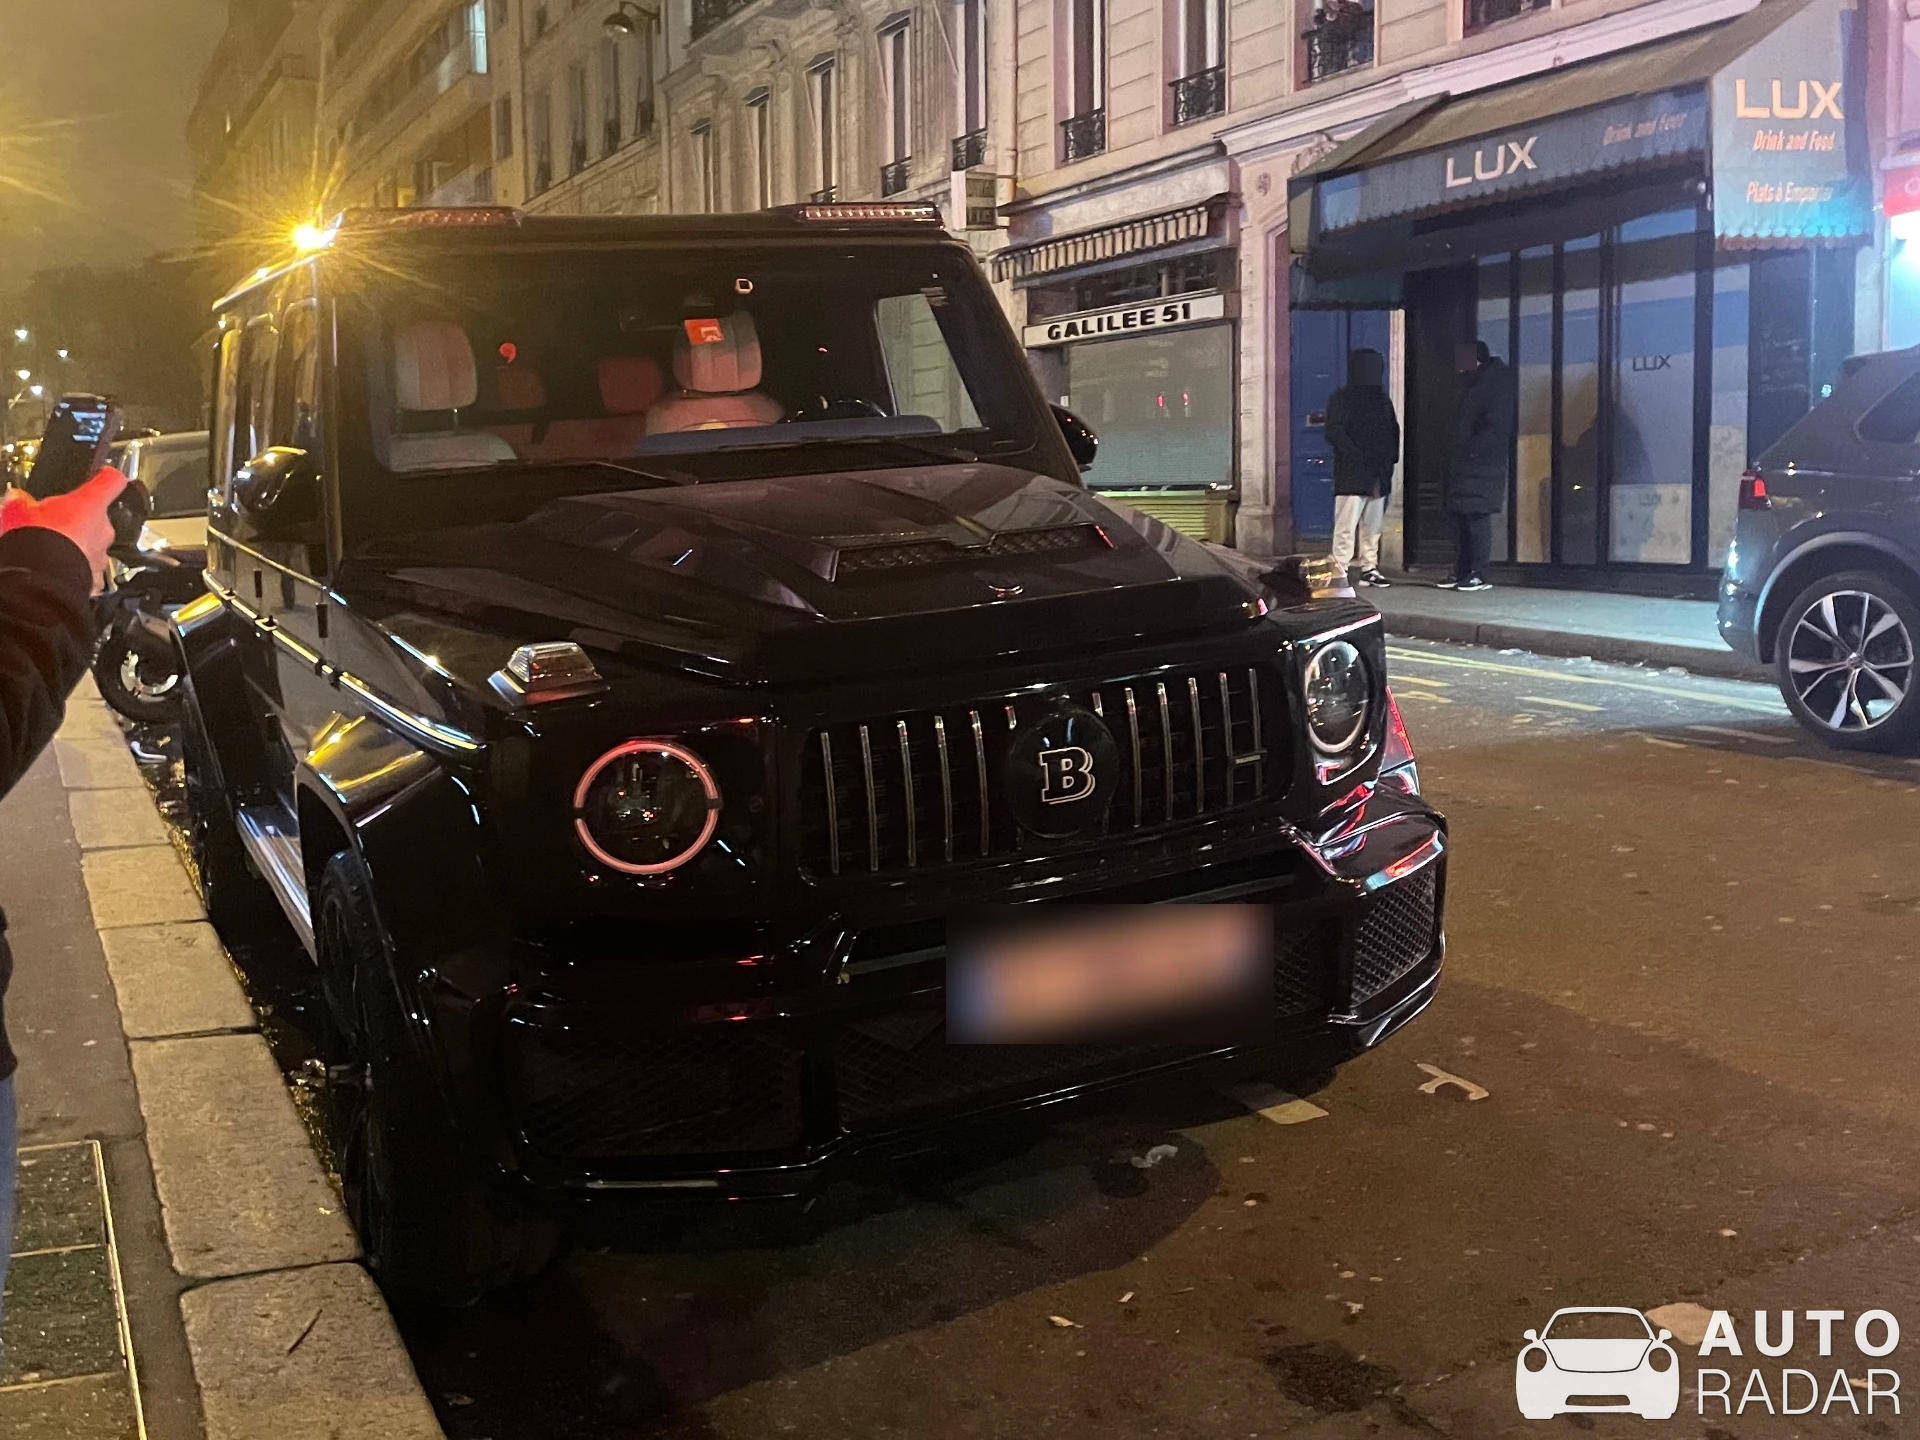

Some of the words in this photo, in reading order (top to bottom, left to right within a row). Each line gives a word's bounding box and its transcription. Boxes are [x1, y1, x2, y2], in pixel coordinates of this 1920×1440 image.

[1735, 79, 1845, 119] LUX
[1752, 129, 1785, 151] Drink
[1786, 131, 1808, 151] and
[1809, 129, 1836, 151] Food
[1446, 136, 1538, 188] LUX
[1746, 181, 1774, 203] Plats
[1047, 309, 1156, 340] GALILEE
[1162, 302, 1191, 322] 51
[1633, 354, 1672, 371] LUX
[1039, 746, 1096, 804] B
